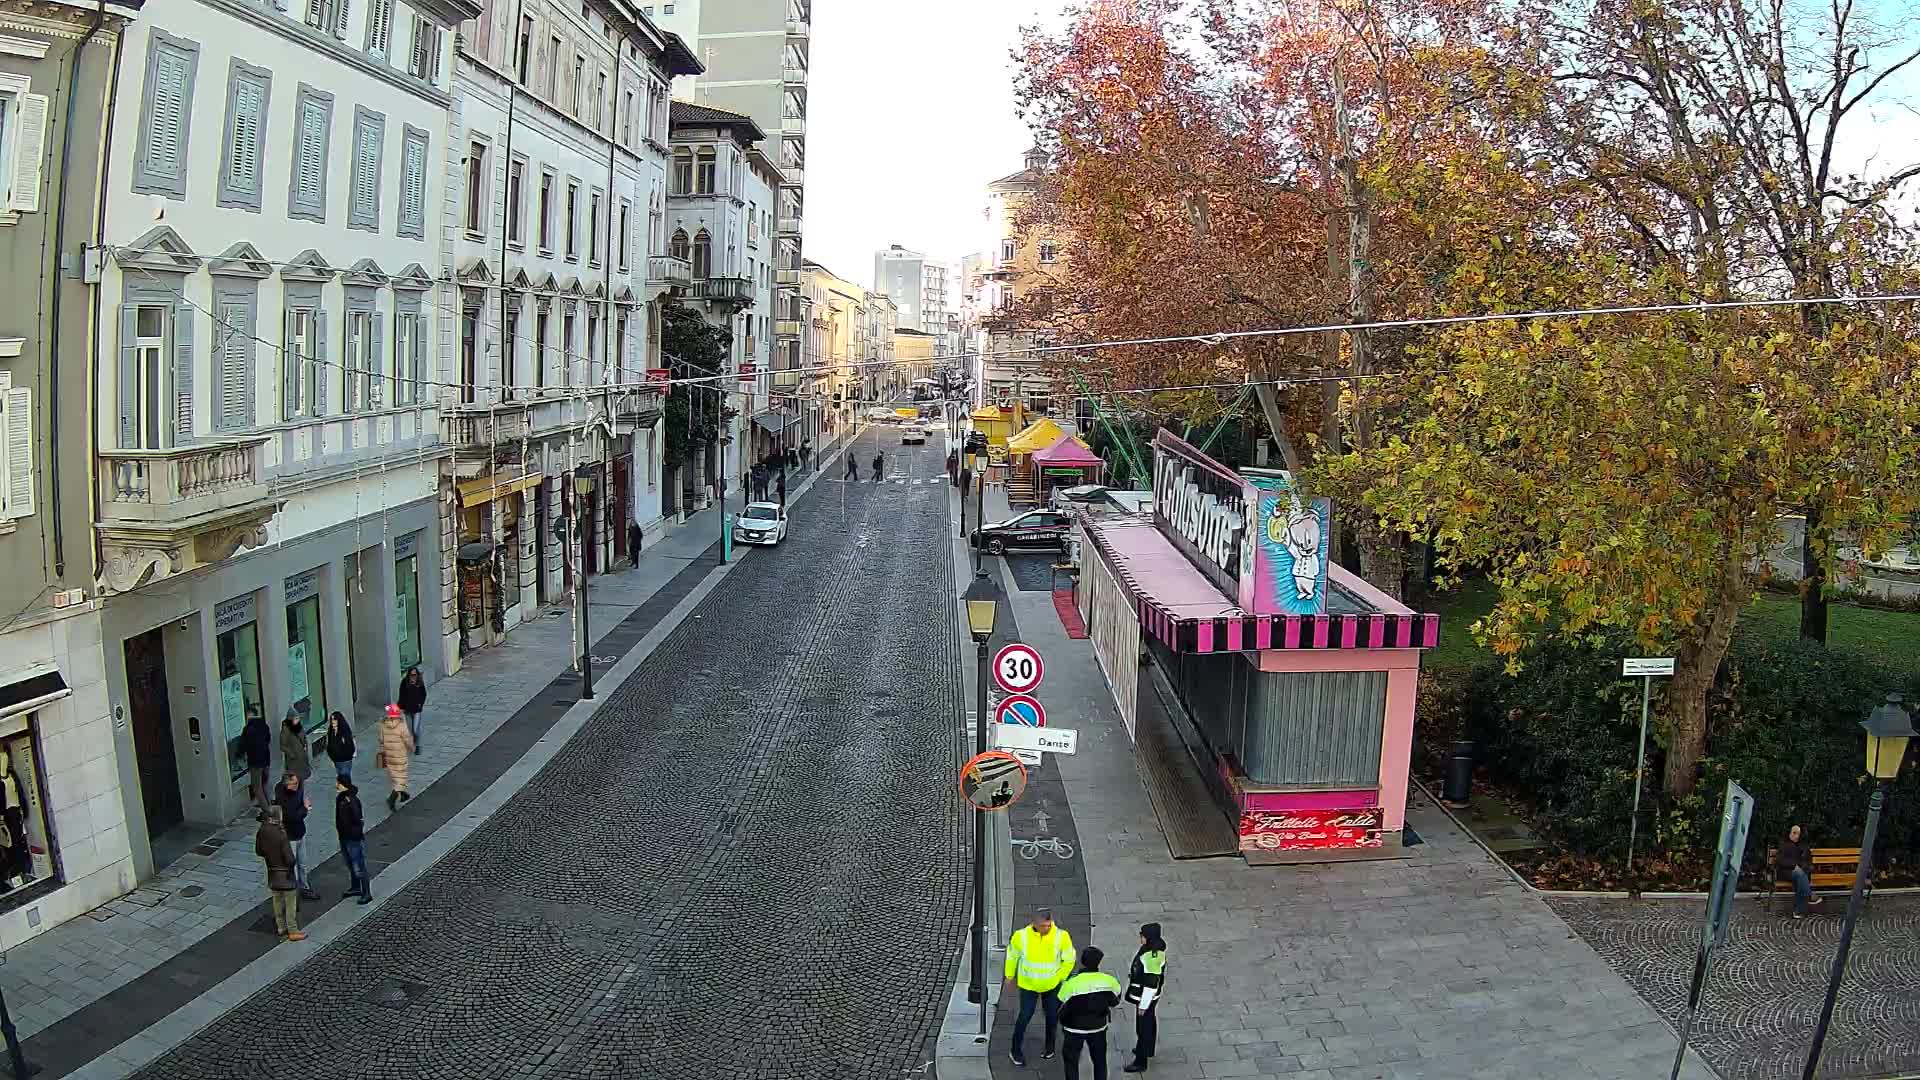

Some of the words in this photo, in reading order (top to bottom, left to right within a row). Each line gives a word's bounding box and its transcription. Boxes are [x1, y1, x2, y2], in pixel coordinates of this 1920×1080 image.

[1162, 459, 1233, 570] Golosone
[1005, 658, 1033, 680] 30
[1038, 737, 1070, 749] Dante
